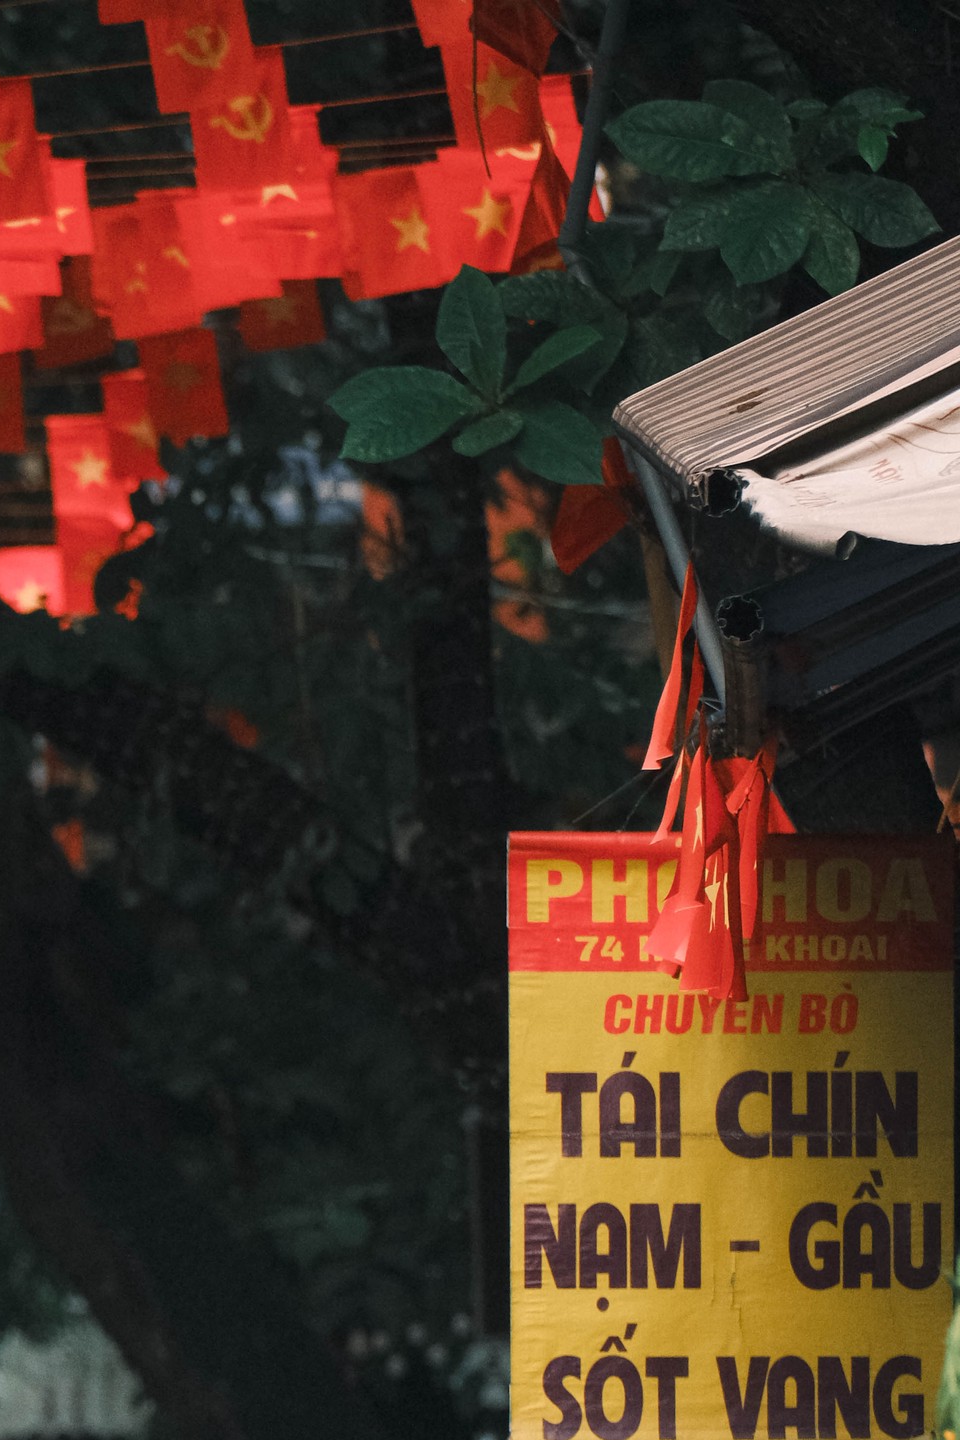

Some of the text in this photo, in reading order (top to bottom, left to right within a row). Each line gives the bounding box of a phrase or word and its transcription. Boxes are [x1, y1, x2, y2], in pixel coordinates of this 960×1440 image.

[574, 935, 625, 962] 74
[765, 935, 888, 962] KHOAI
[797, 981, 860, 1035] BÒ
[545, 1051, 919, 1159] TÁI CHÍN
[523, 1203, 702, 1312] NẠM
[788, 1169, 942, 1291] GẦU
